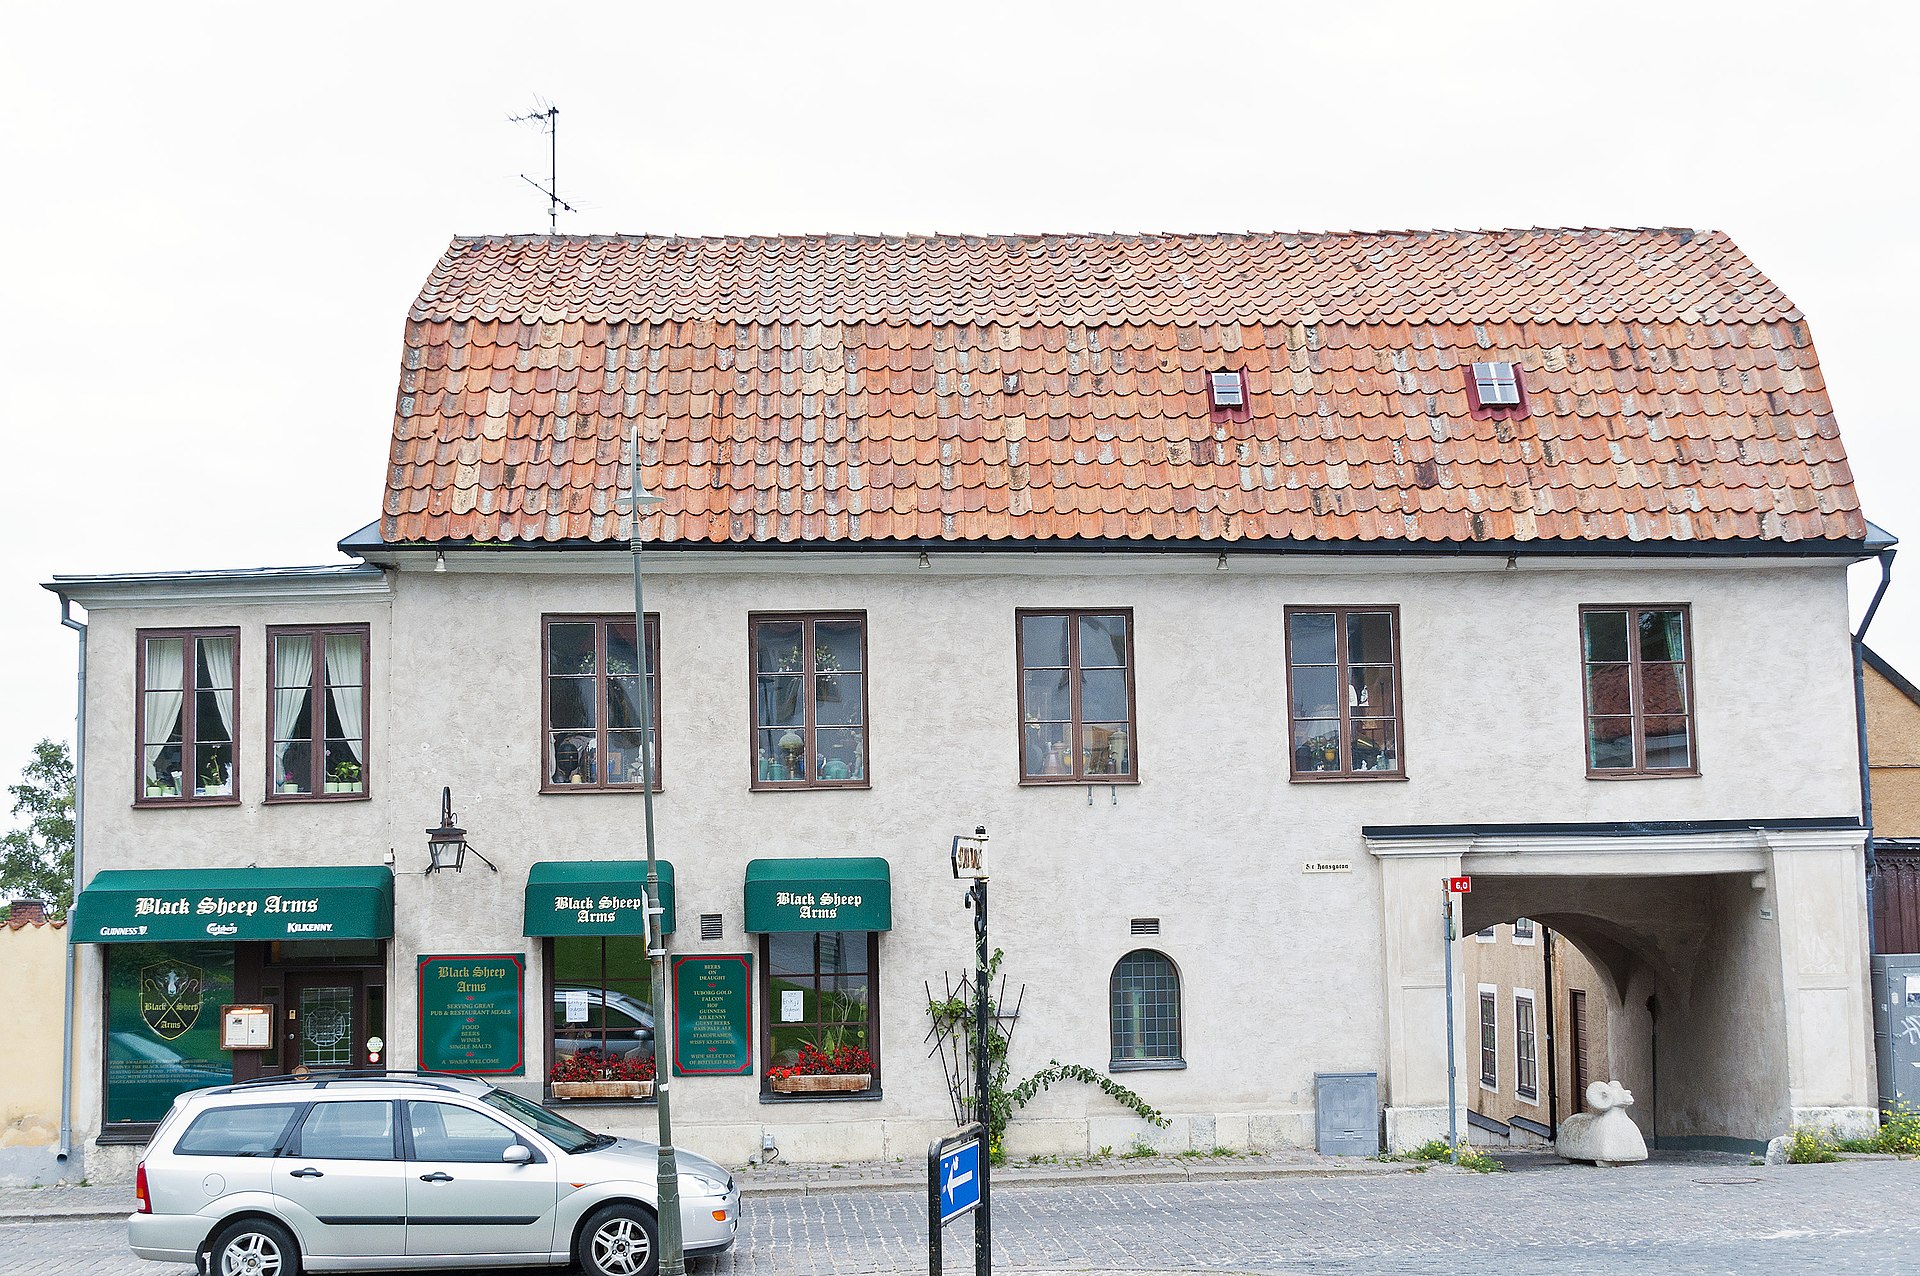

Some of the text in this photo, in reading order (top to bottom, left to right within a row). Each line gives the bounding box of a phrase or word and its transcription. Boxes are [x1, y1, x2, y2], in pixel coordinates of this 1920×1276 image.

[134, 895, 319, 918] Black Sheep Arms
[554, 896, 641, 912] Black Sheep
[776, 892, 862, 908] Black Sheep
[577, 909, 616, 923] Arms
[799, 905, 838, 919] Arms
[100, 926, 139, 936] GUINNESS
[206, 922, 238, 936] Carlsberg
[438, 966, 506, 979] Black Sheep
[457, 981, 487, 993] Arms
[144, 1002, 199, 1012] Black Sheep
[160, 1020, 182, 1029] Arms
